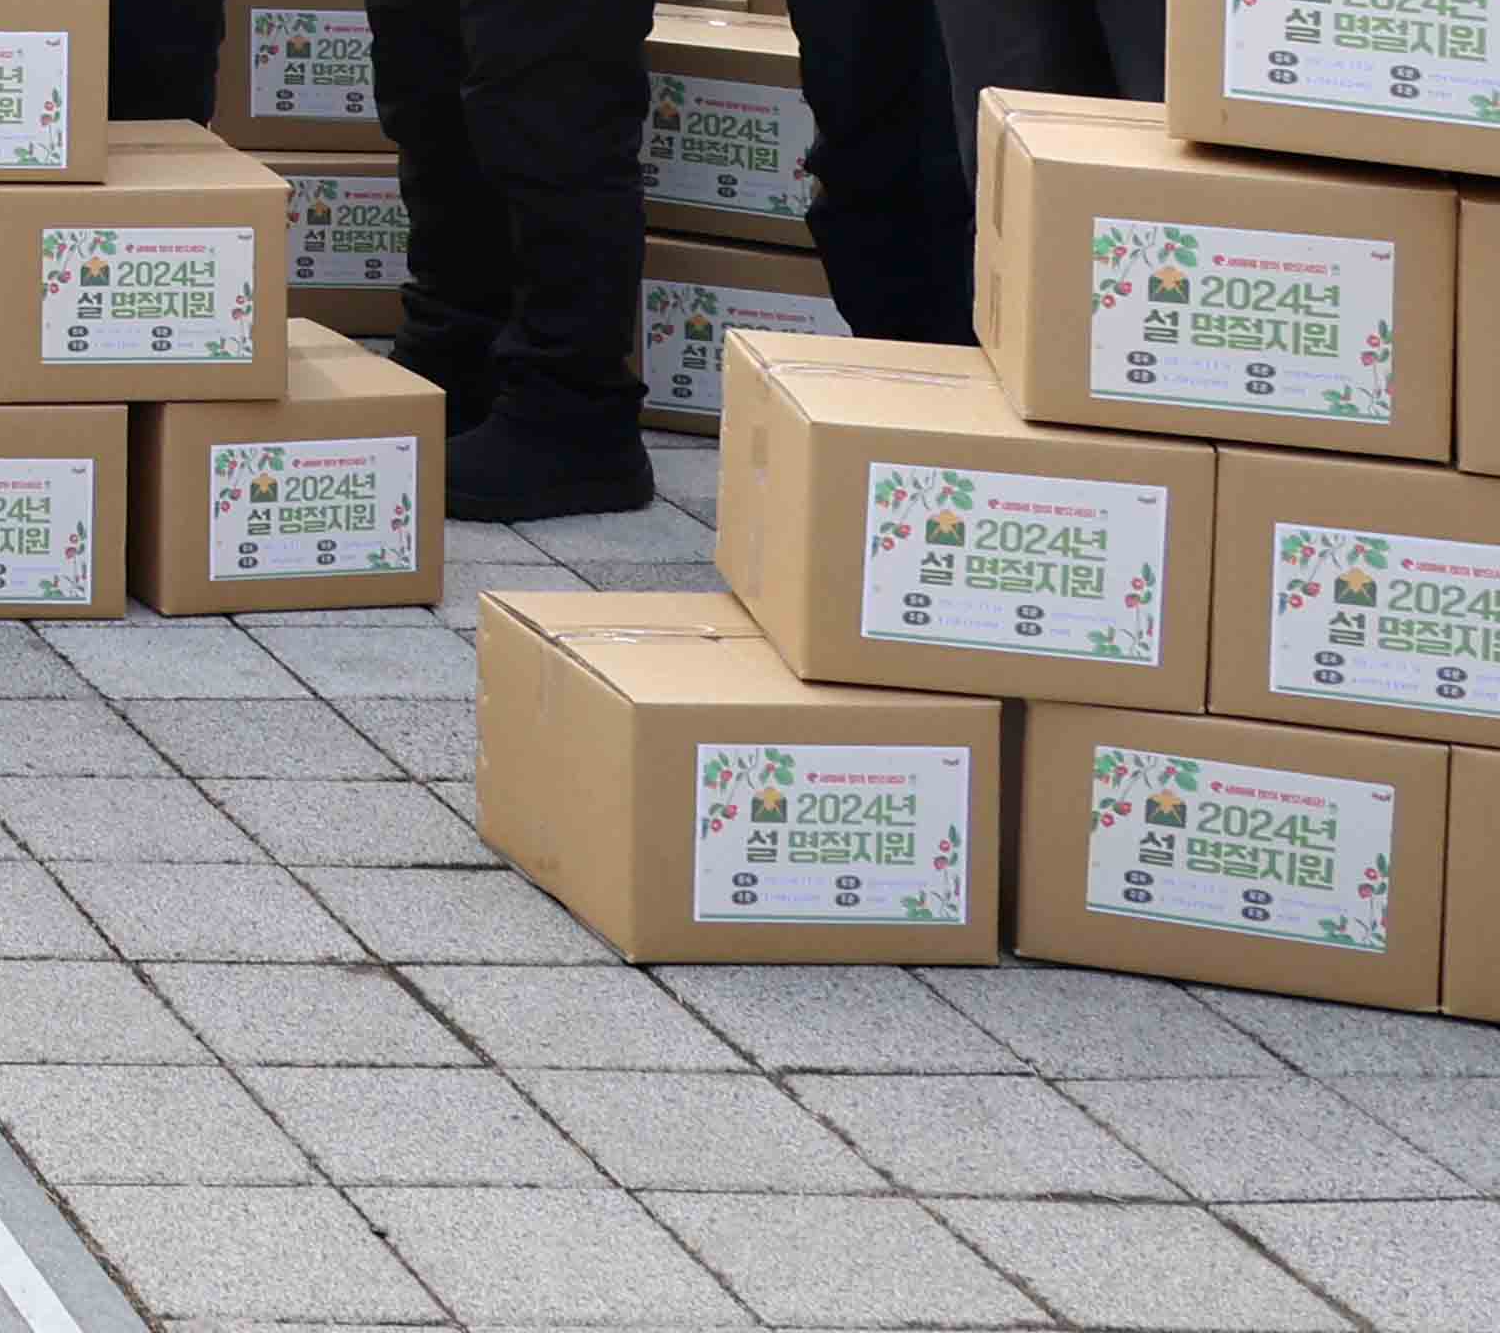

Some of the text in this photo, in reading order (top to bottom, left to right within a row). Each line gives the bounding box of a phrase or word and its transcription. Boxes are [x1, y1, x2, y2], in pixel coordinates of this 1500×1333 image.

[1283, 8, 1485, 62] 설 명절지원
[688, 113, 780, 145] 2024년
[682, 138, 780, 173] 명절지원
[1200, 275, 1338, 318] 2024년
[1143, 308, 1336, 358] 설 명절지원
[975, 518, 1107, 561] 2024년
[918, 551, 1104, 600] 설 명절지원
[1388, 579, 1500, 624] 2024
[1328, 611, 1500, 662] 설 명절지
[796, 792, 916, 826] 2024년
[1197, 803, 1335, 851] 2024년
[745, 830, 914, 865] 설 명절지원
[1140, 831, 1333, 889] 설 명절지원
